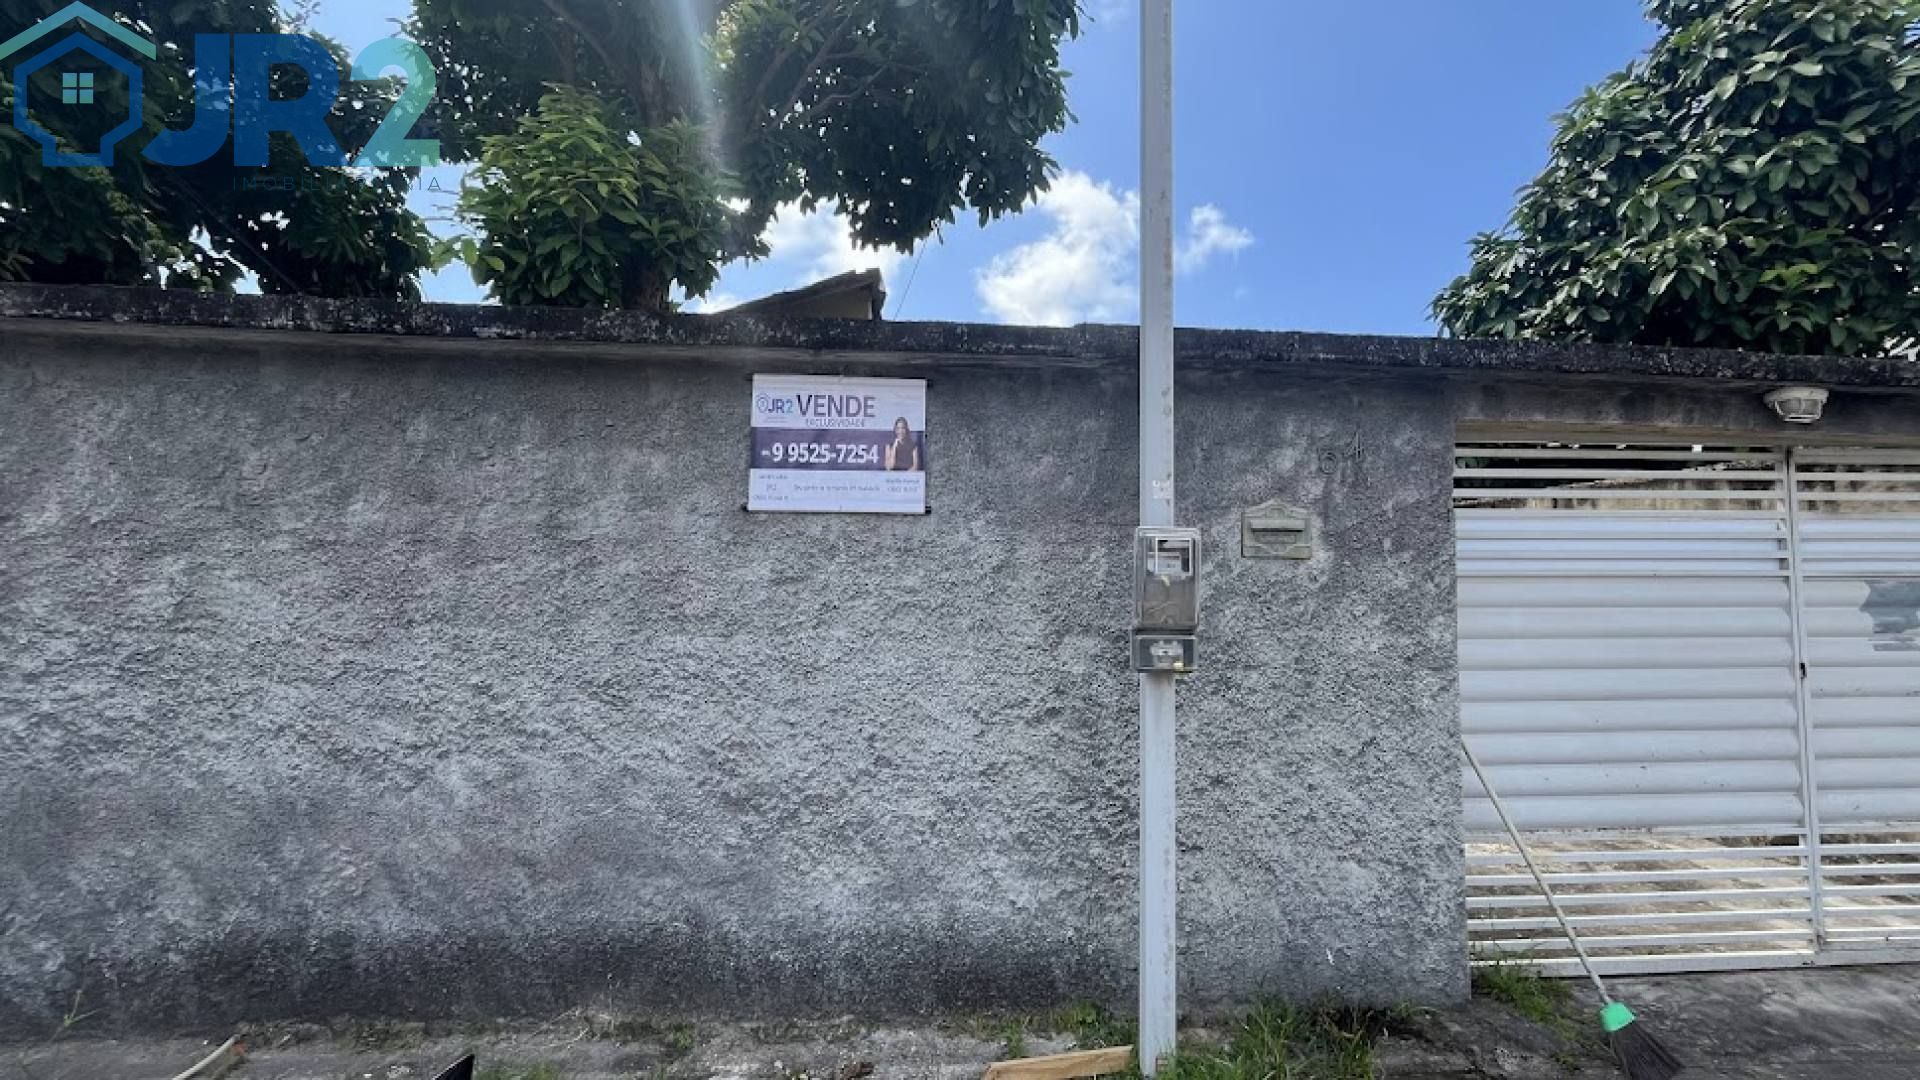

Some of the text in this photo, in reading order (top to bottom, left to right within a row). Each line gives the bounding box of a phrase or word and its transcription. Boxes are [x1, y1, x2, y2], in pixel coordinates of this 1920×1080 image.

[768, 394, 876, 418] JR2 VENDE
[787, 442, 880, 464] 9525-7254
